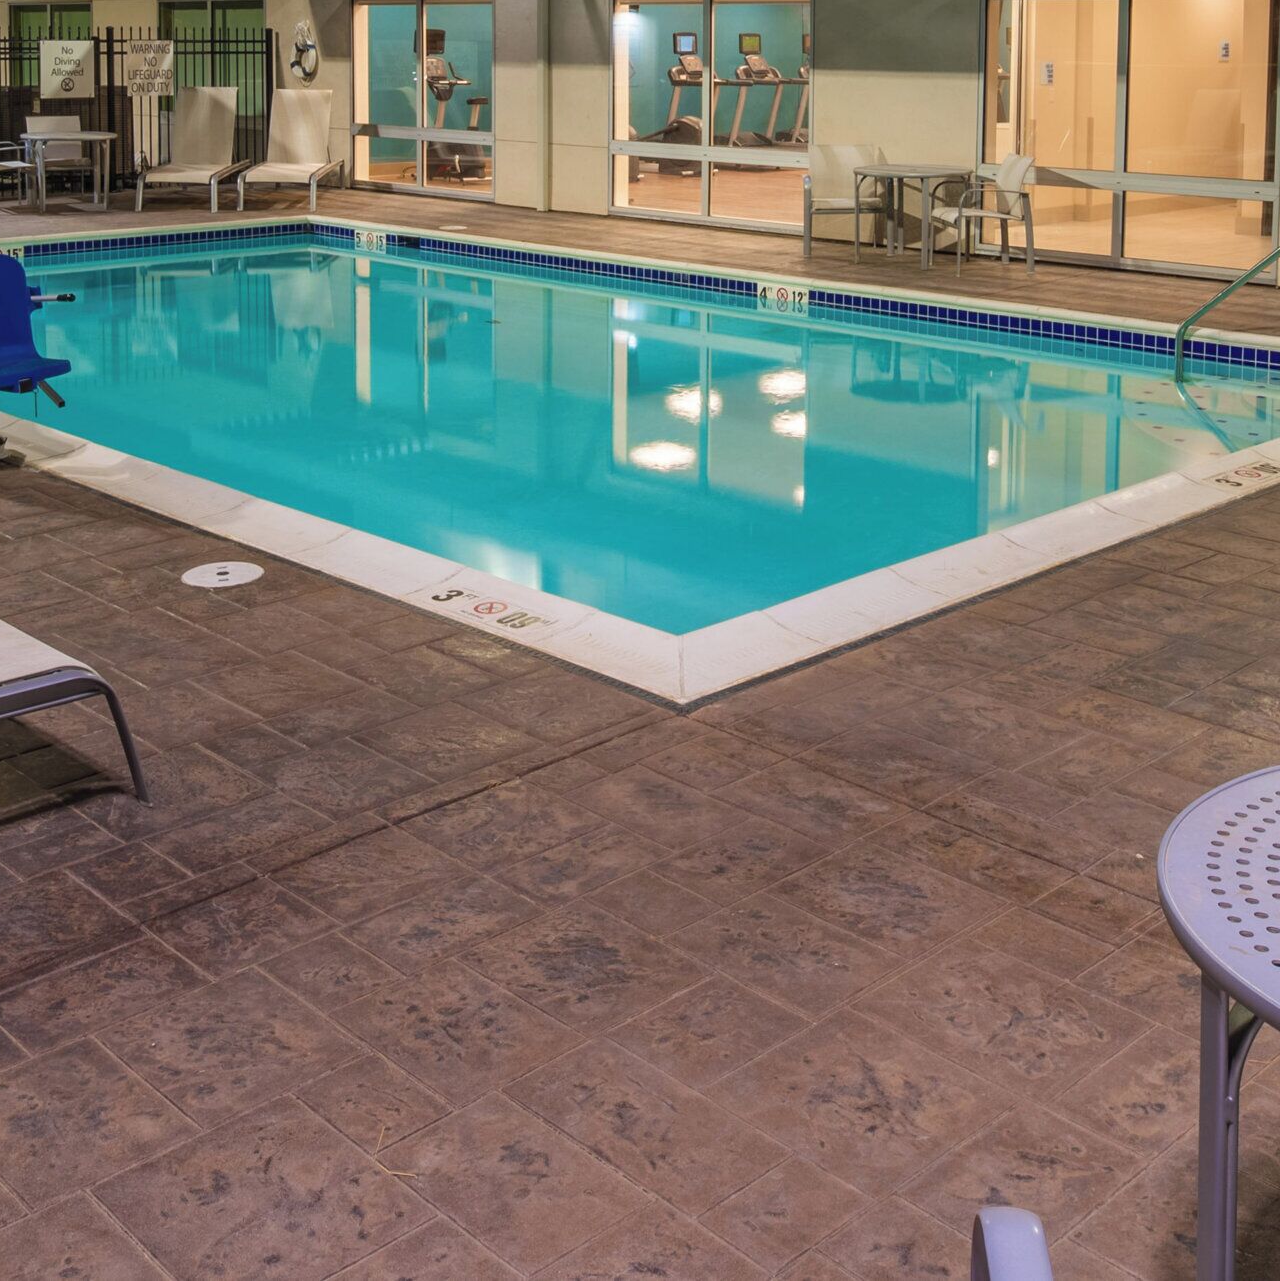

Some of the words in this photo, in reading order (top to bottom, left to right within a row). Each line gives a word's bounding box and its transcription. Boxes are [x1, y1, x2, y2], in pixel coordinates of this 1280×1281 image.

[61, 46, 74, 55] No
[130, 44, 170, 54] WARNING
[54, 57, 81, 67] Diving
[144, 57, 157, 67] NO
[51, 68, 84, 77] Allowed
[128, 69, 173, 80] LIFEGUARD
[131, 83, 145, 93] ON
[147, 82, 170, 93] DUTY
[431, 589, 464, 602] 3
